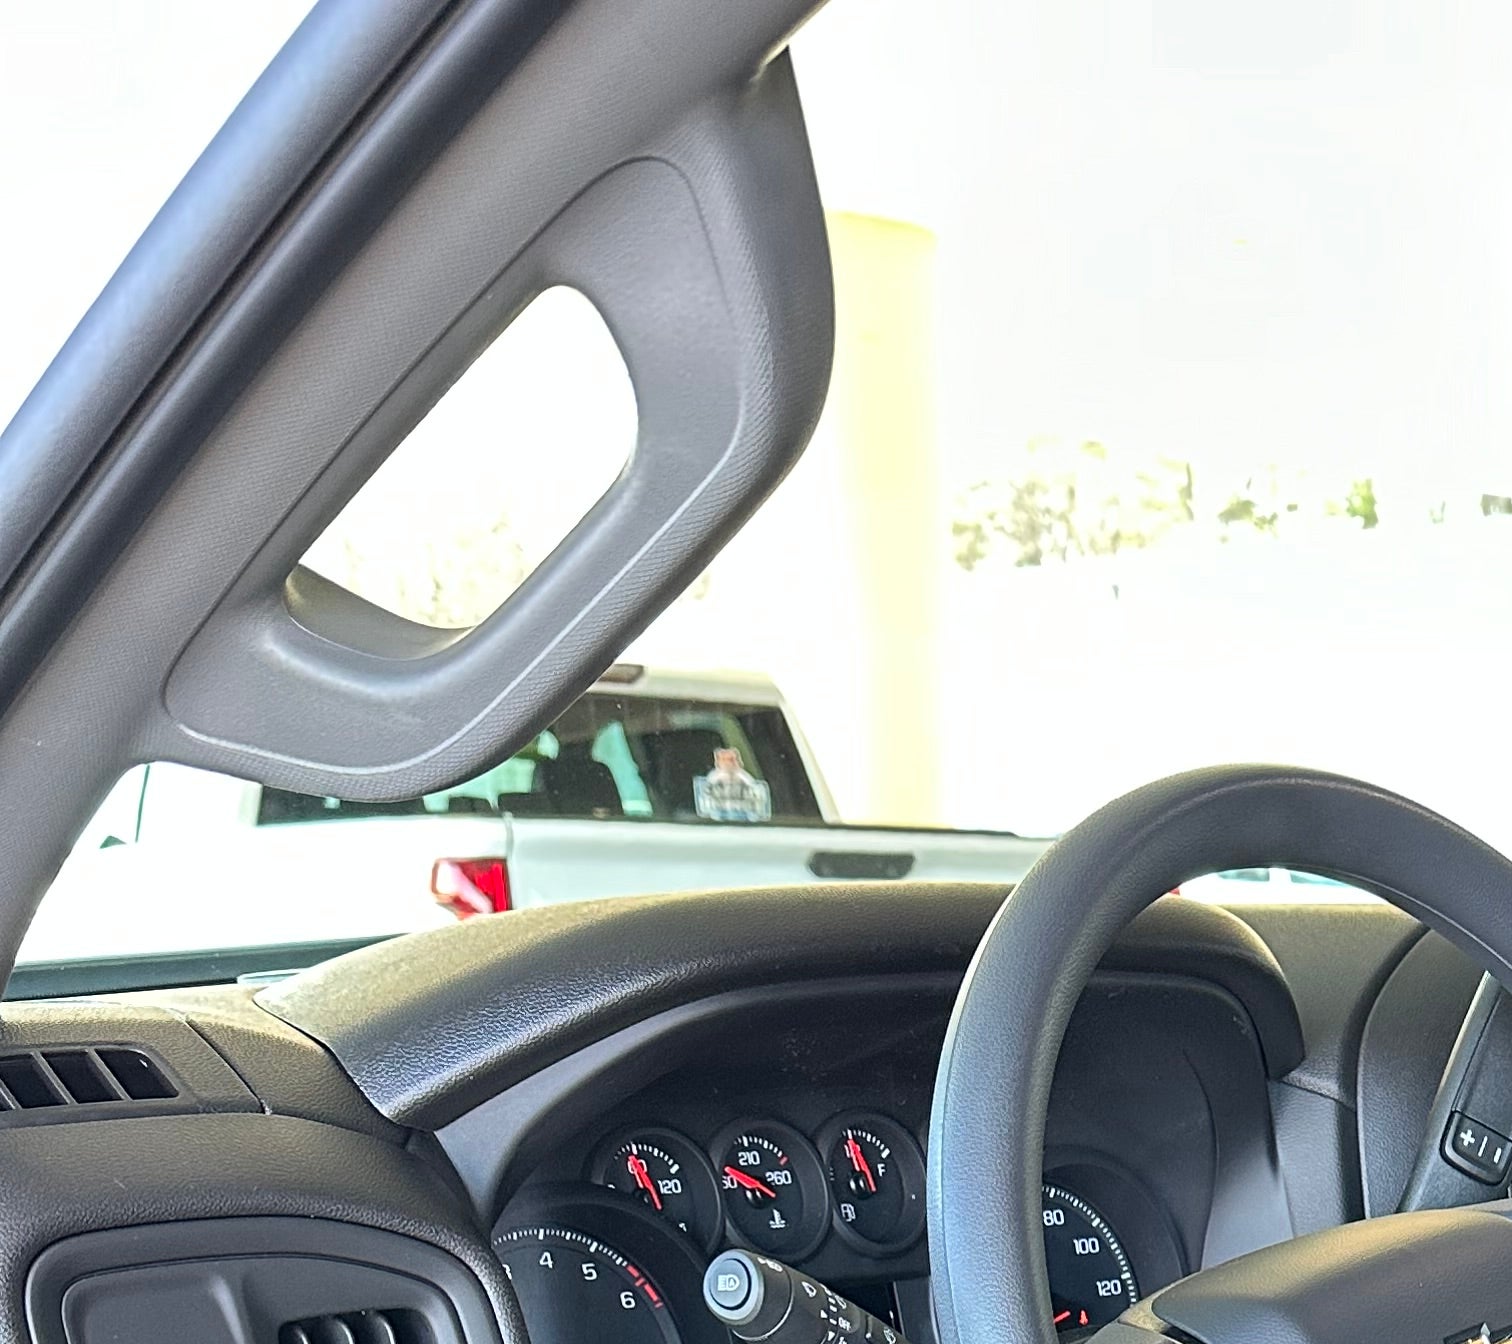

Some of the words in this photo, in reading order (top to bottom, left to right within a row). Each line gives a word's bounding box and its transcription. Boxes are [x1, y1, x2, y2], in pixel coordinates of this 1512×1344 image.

[738, 1151, 760, 1166] 210
[877, 1163, 886, 1176] F
[657, 1178, 682, 1194] 120
[1042, 1208, 1065, 1227] 80
[1072, 1236, 1100, 1256] 100
[538, 1251, 554, 1269] 4
[581, 1262, 598, 1281] 5
[1095, 1279, 1122, 1297] 120
[619, 1290, 636, 1309] 6
